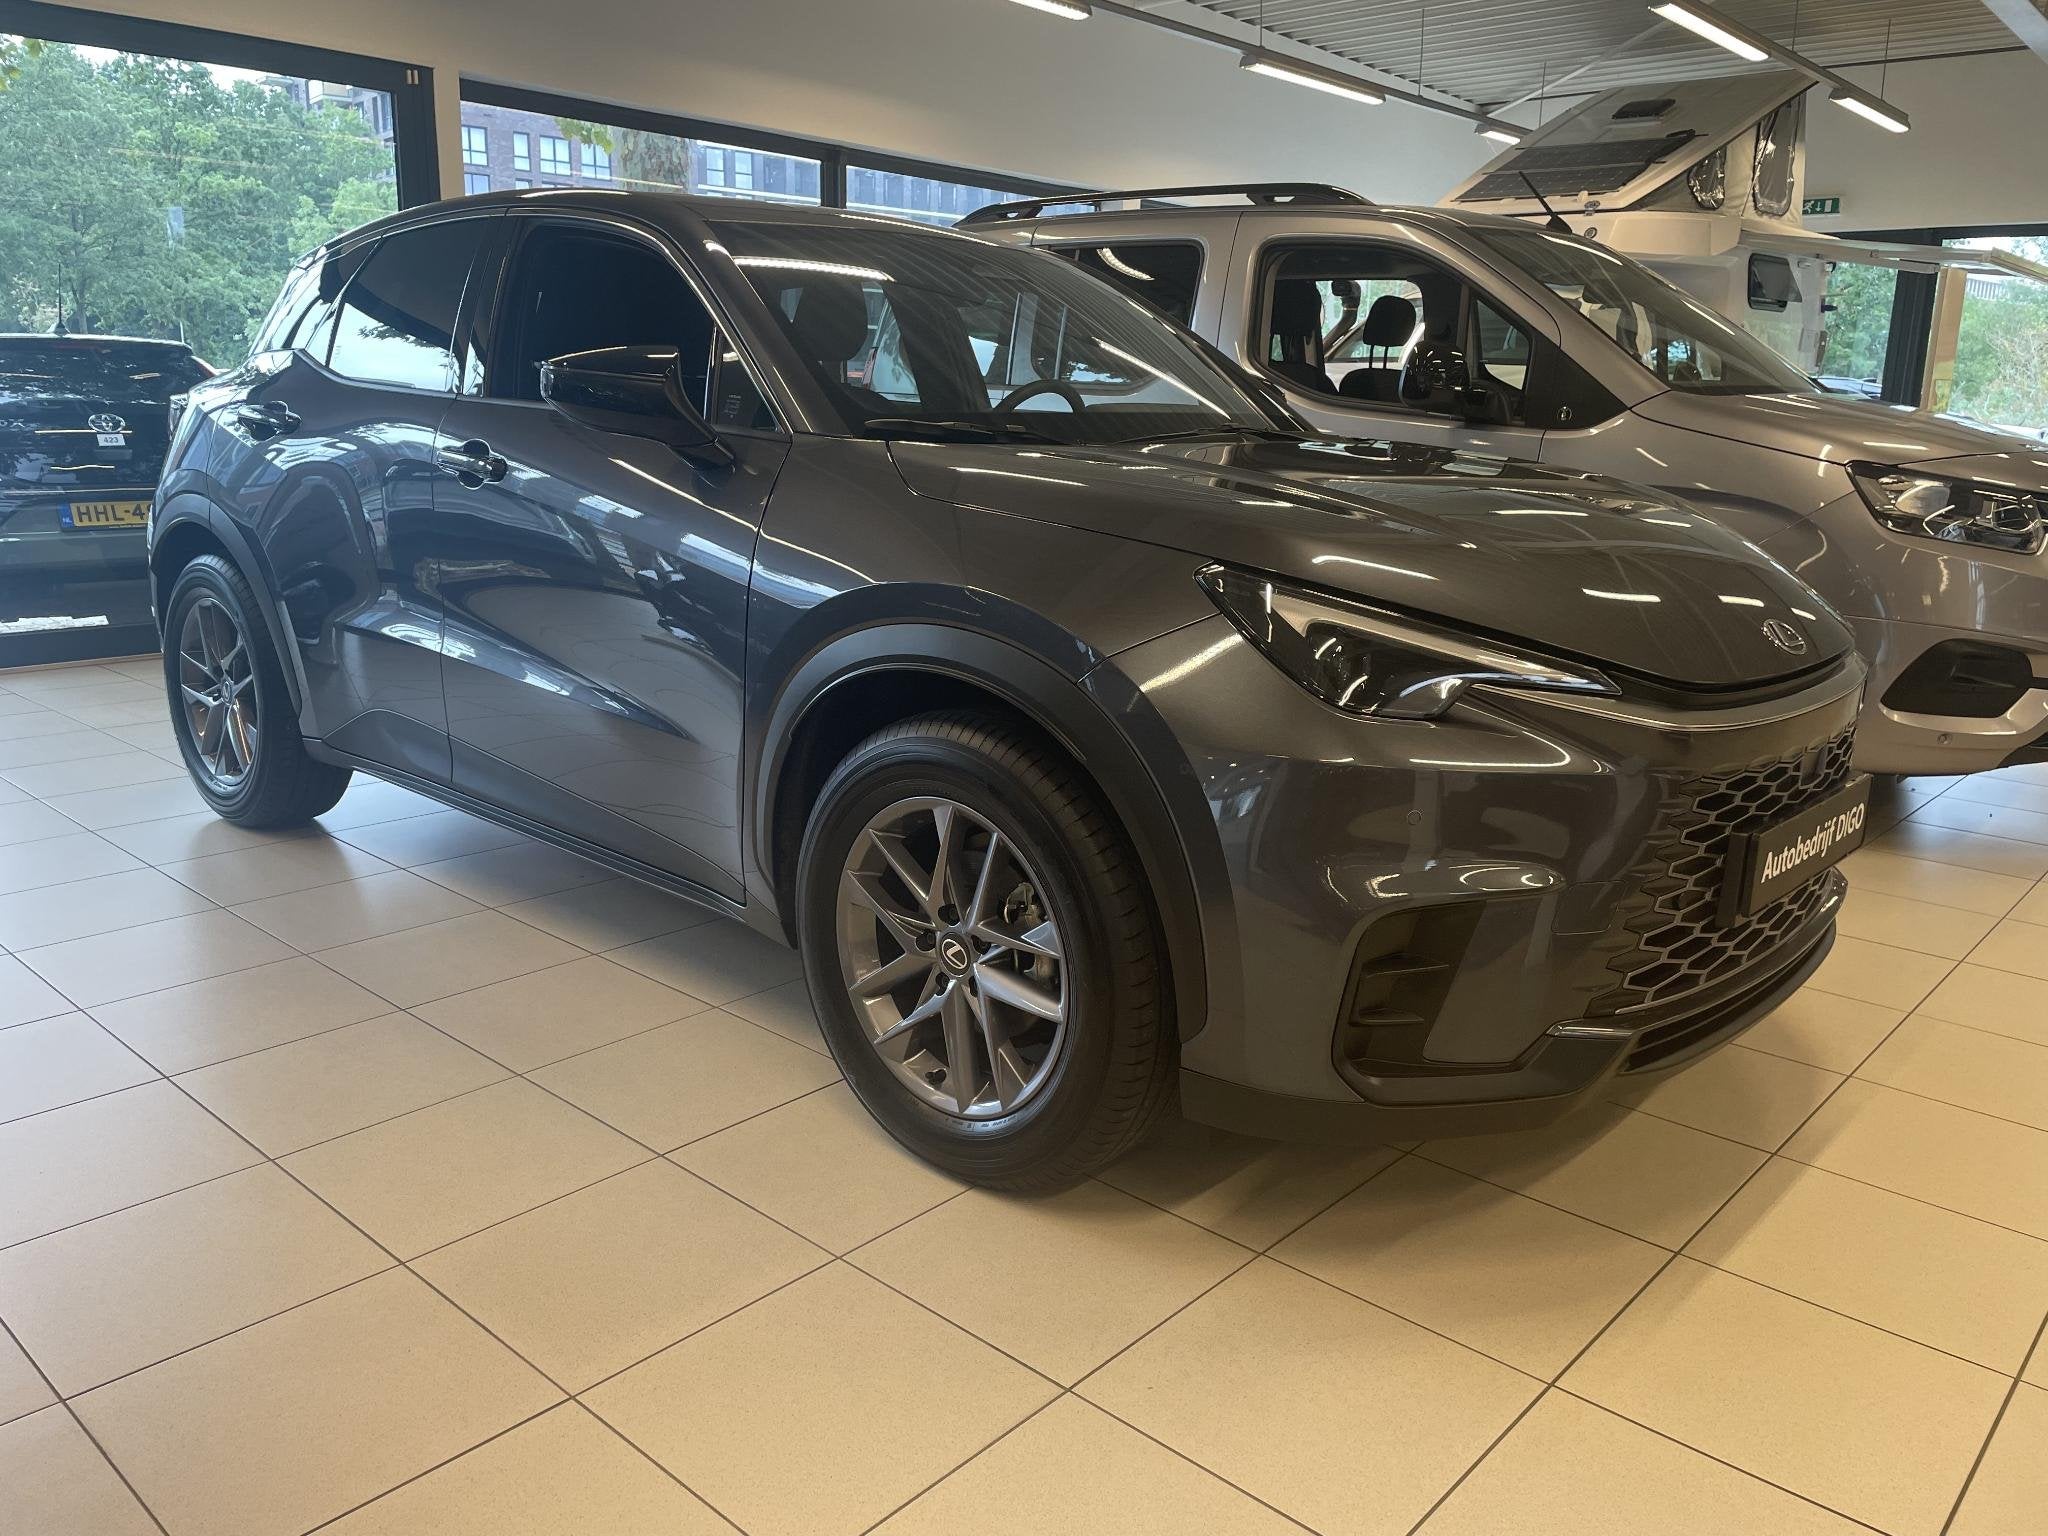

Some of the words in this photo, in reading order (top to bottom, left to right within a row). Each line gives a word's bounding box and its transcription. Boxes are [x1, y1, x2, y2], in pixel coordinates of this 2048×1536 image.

[103, 436, 119, 444] 423
[1761, 817, 1837, 884] Autobedrijf
[1836, 803, 1865, 842] DIGO
